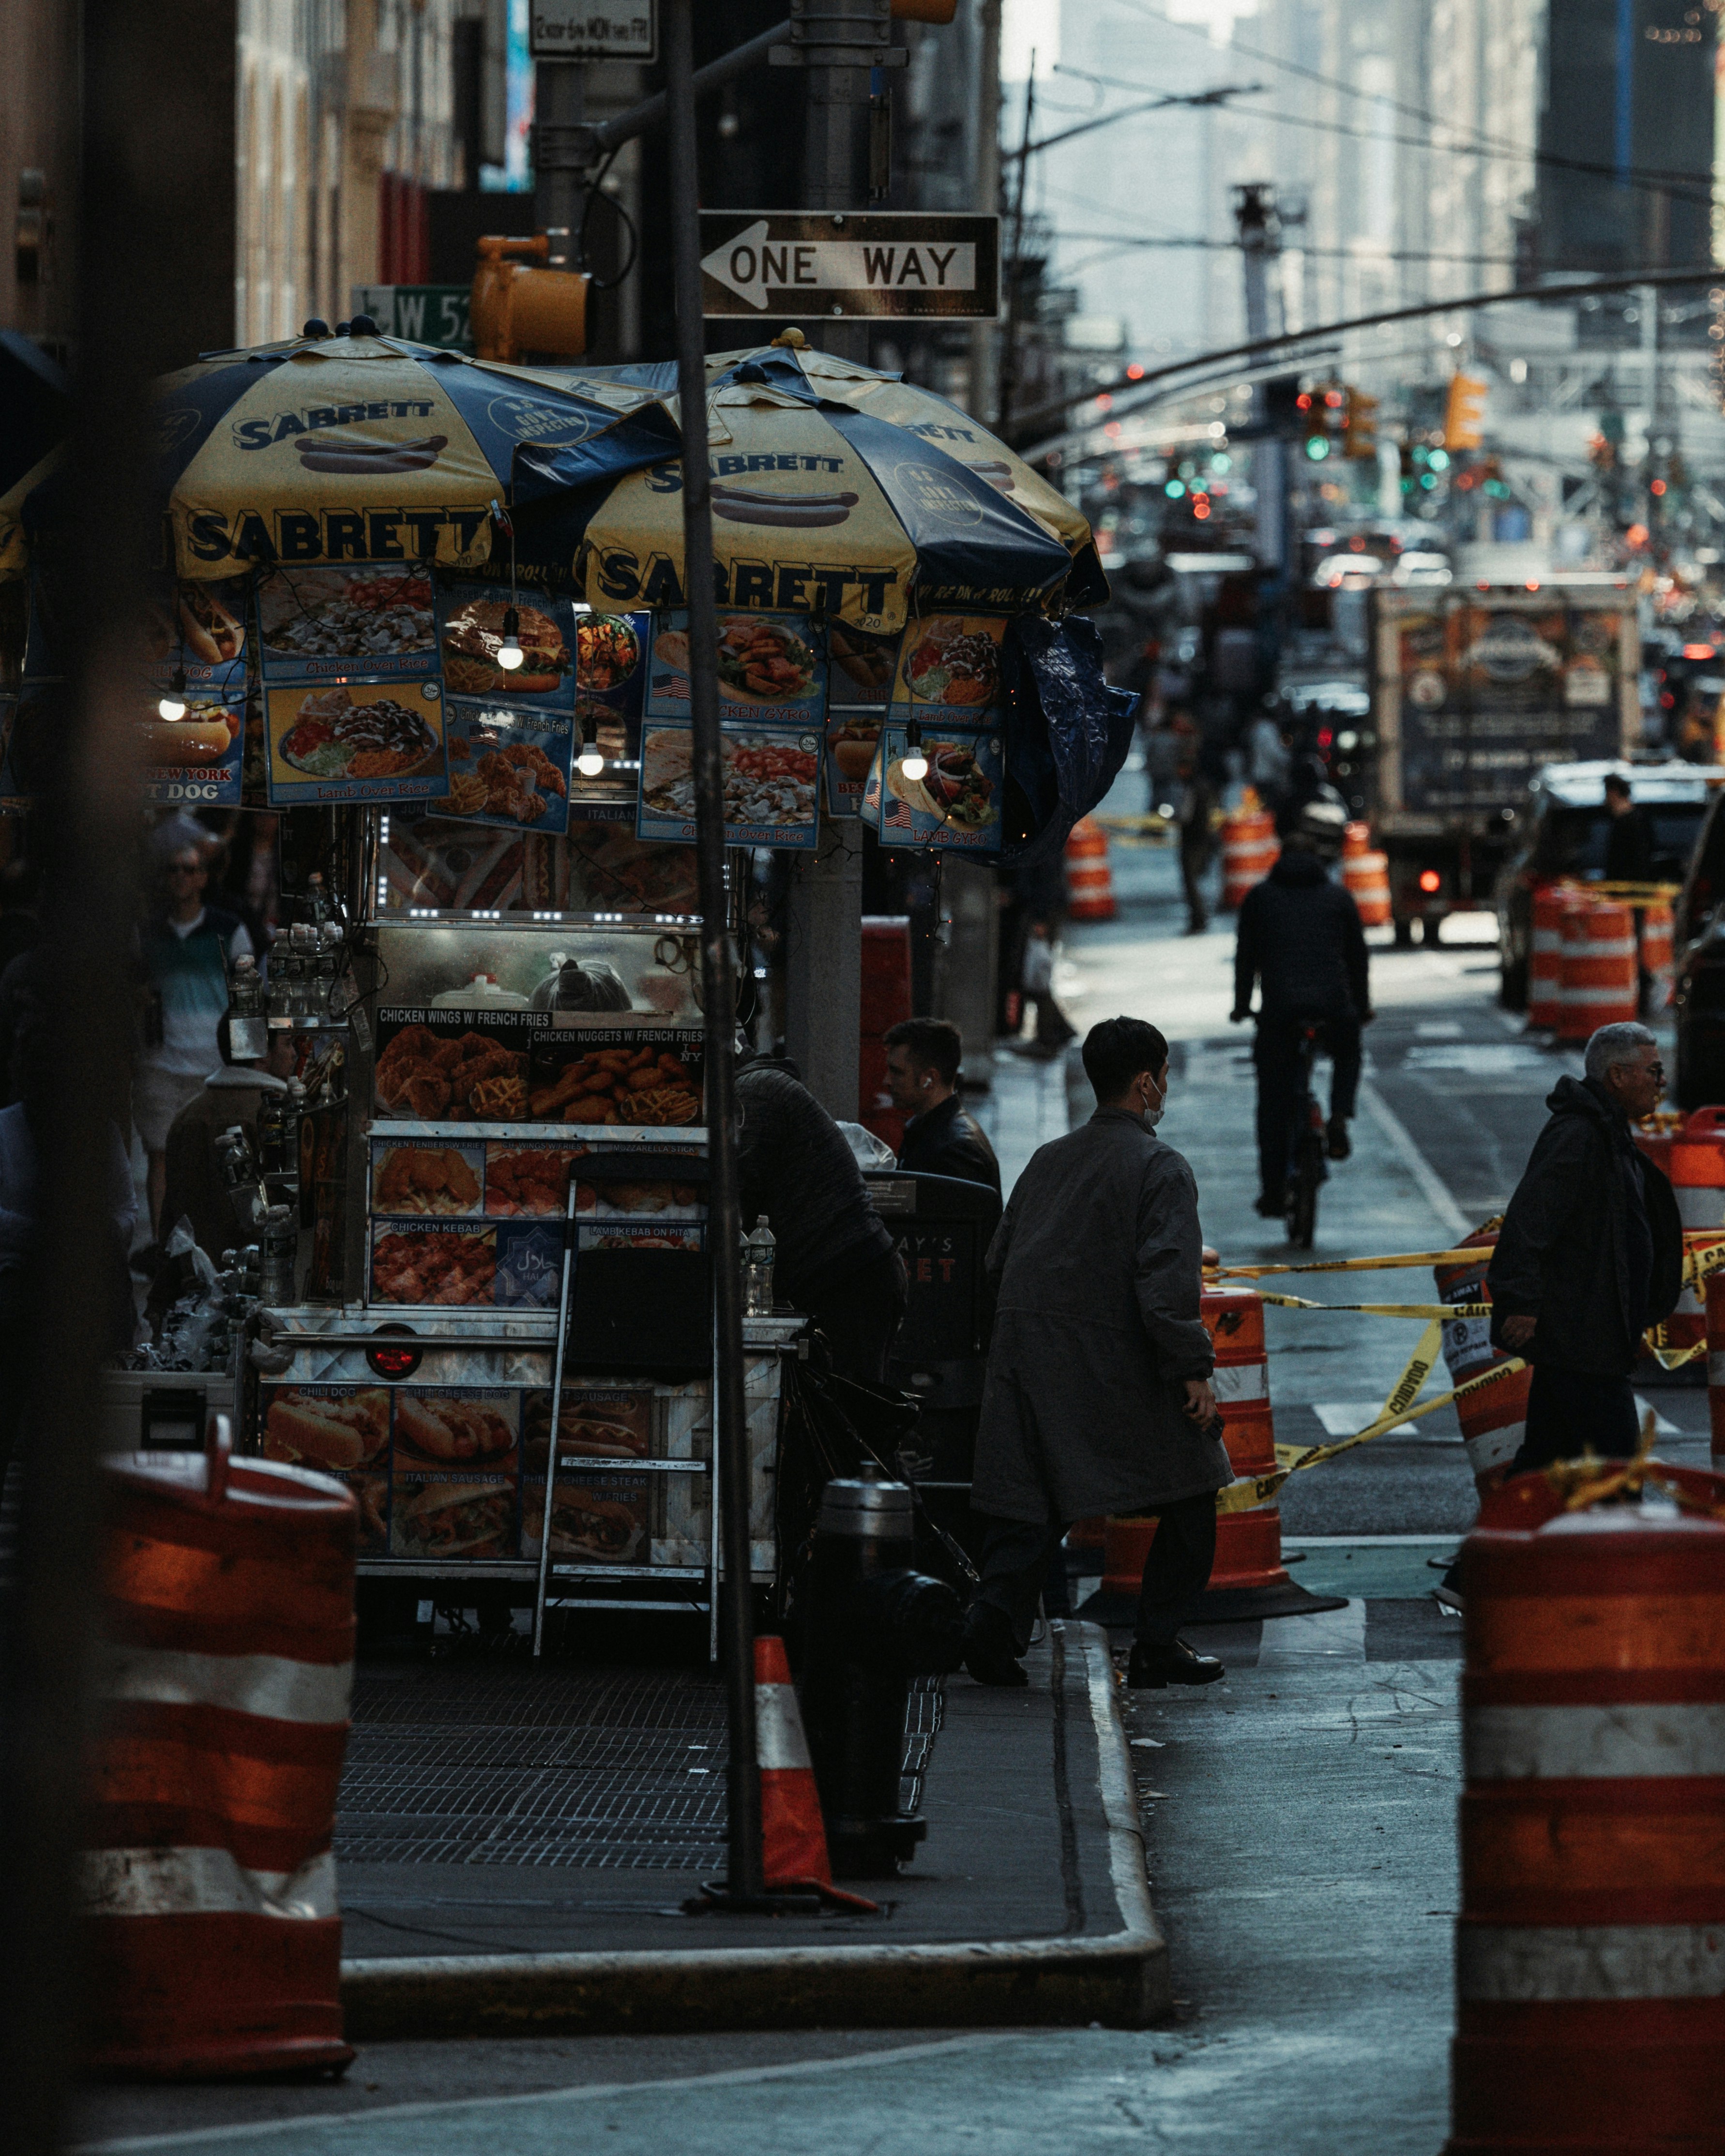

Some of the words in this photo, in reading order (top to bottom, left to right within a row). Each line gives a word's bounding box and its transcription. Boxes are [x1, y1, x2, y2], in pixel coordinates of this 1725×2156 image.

[730, 245, 817, 284] ONE
[863, 247, 956, 285] WAY
[397, 295, 425, 339] W
[232, 398, 435, 451] SABRETT
[515, 416, 584, 439] INSPECTED
[644, 451, 844, 493] SBRETT
[187, 505, 488, 562] SABRETT
[518, 593, 548, 608] French
[623, 614, 636, 626] MIX
[854, 617, 880, 628] 2020
[306, 659, 361, 674] Chicken
[363, 659, 395, 672] Over
[398, 658, 428, 670] Rice
[719, 705, 760, 718] CKEN
[765, 708, 810, 721] GYRO
[919, 709, 945, 723] Lamb
[948, 711, 969, 723] Over
[527, 717, 550, 732] French
[552, 720, 569, 735] Fries
[185, 768, 232, 781] YORK
[166, 783, 219, 799] DOG
[317, 786, 356, 799] Lamb
[360, 784, 393, 797] Over
[398, 783, 429, 795] Rice
[838, 782, 865, 794] BES
[588, 809, 637, 822] ITALIAN
[739, 828, 771, 840] Over
[774, 829, 803, 841] Rice
[913, 830, 950, 843] LAMB
[953, 832, 987, 845] GYRO
[380, 1009, 425, 1023] CHICKEN
[427, 1010, 460, 1024] WINGS
[463, 1011, 475, 1025] W/
[478, 1012, 517, 1025] FRENCH
[520, 1013, 549, 1027] FRIES
[533, 1031, 575, 1042] CHICKEN
[577, 1030, 621, 1042] NUGGETS
[624, 1030, 635, 1041] W/
[637, 1030, 674, 1041] FRENCH
[676, 1031, 703, 1042] FRIES
[683, 1043, 689, 1053] I
[680, 1053, 702, 1062] NY
[612, 1144, 668, 1153] MOZZARELLA
[391, 1222, 440, 1233] CHICKEN
[442, 1223, 481, 1234] KEBAB
[590, 1227, 616, 1236] LAMB
[619, 1227, 651, 1236] KEBAB
[653, 1228, 667, 1237] ON
[669, 1228, 690, 1237] PITA
[516, 1250, 560, 1271] حلال
[299, 1387, 329, 1397] CHILI
[331, 1387, 357, 1397] DOG
[406, 1388, 435, 1398] CHILI
[438, 1389, 482, 1399] CHEESE
[484, 1389, 511, 1400] DOG
[574, 1391, 629, 1402] SAUSAGE
[406, 1473, 448, 1483] ITALIAN
[451, 1474, 505, 1484] SAUSAGE
[523, 1476, 561, 1486] PHILY
[563, 1476, 608, 1486] CHEESE
[611, 1477, 647, 1486] STEAK
[592, 1492, 638, 1502] W/FRIES
